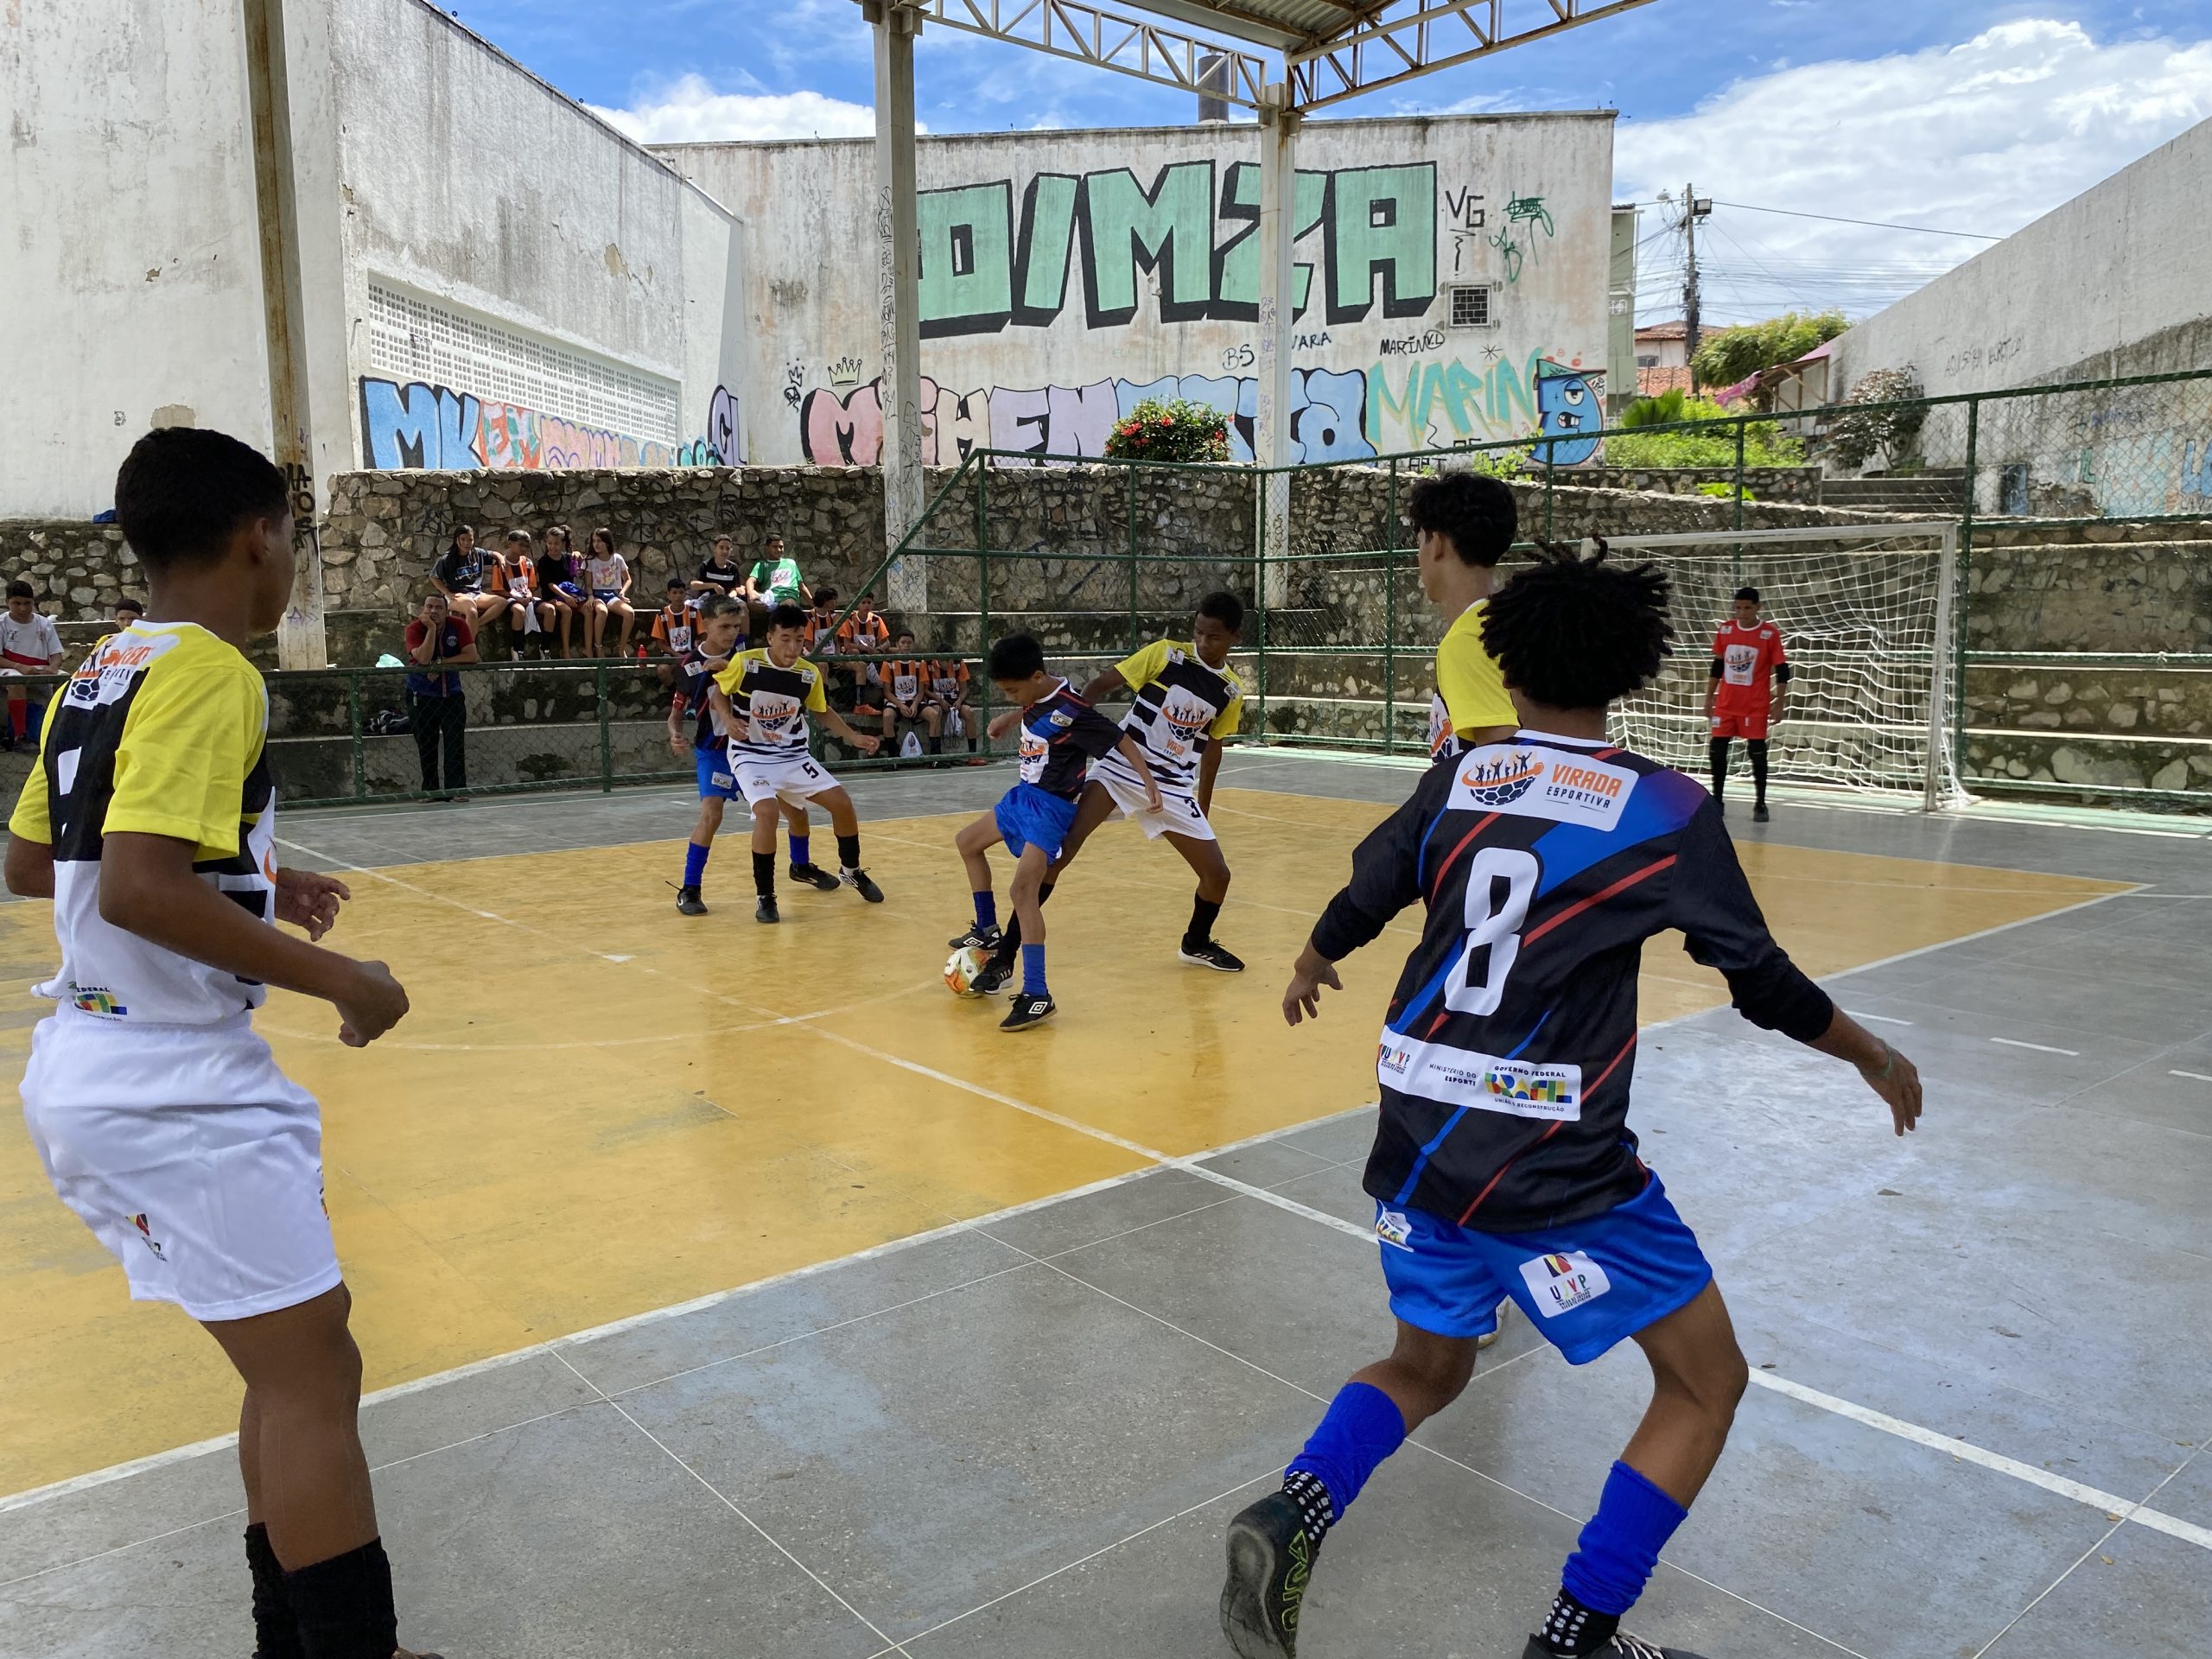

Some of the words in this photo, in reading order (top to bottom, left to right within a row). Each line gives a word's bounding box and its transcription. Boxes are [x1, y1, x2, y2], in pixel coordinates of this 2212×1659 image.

[802, 761, 819, 779] 5
[1551, 764, 1623, 798] VIRADA
[1184, 798, 1201, 818] 3
[1546, 785, 1611, 809] ESPORTIVA
[1445, 847, 1539, 1016] 8
[1494, 1065, 1529, 1076] GOVERNO
